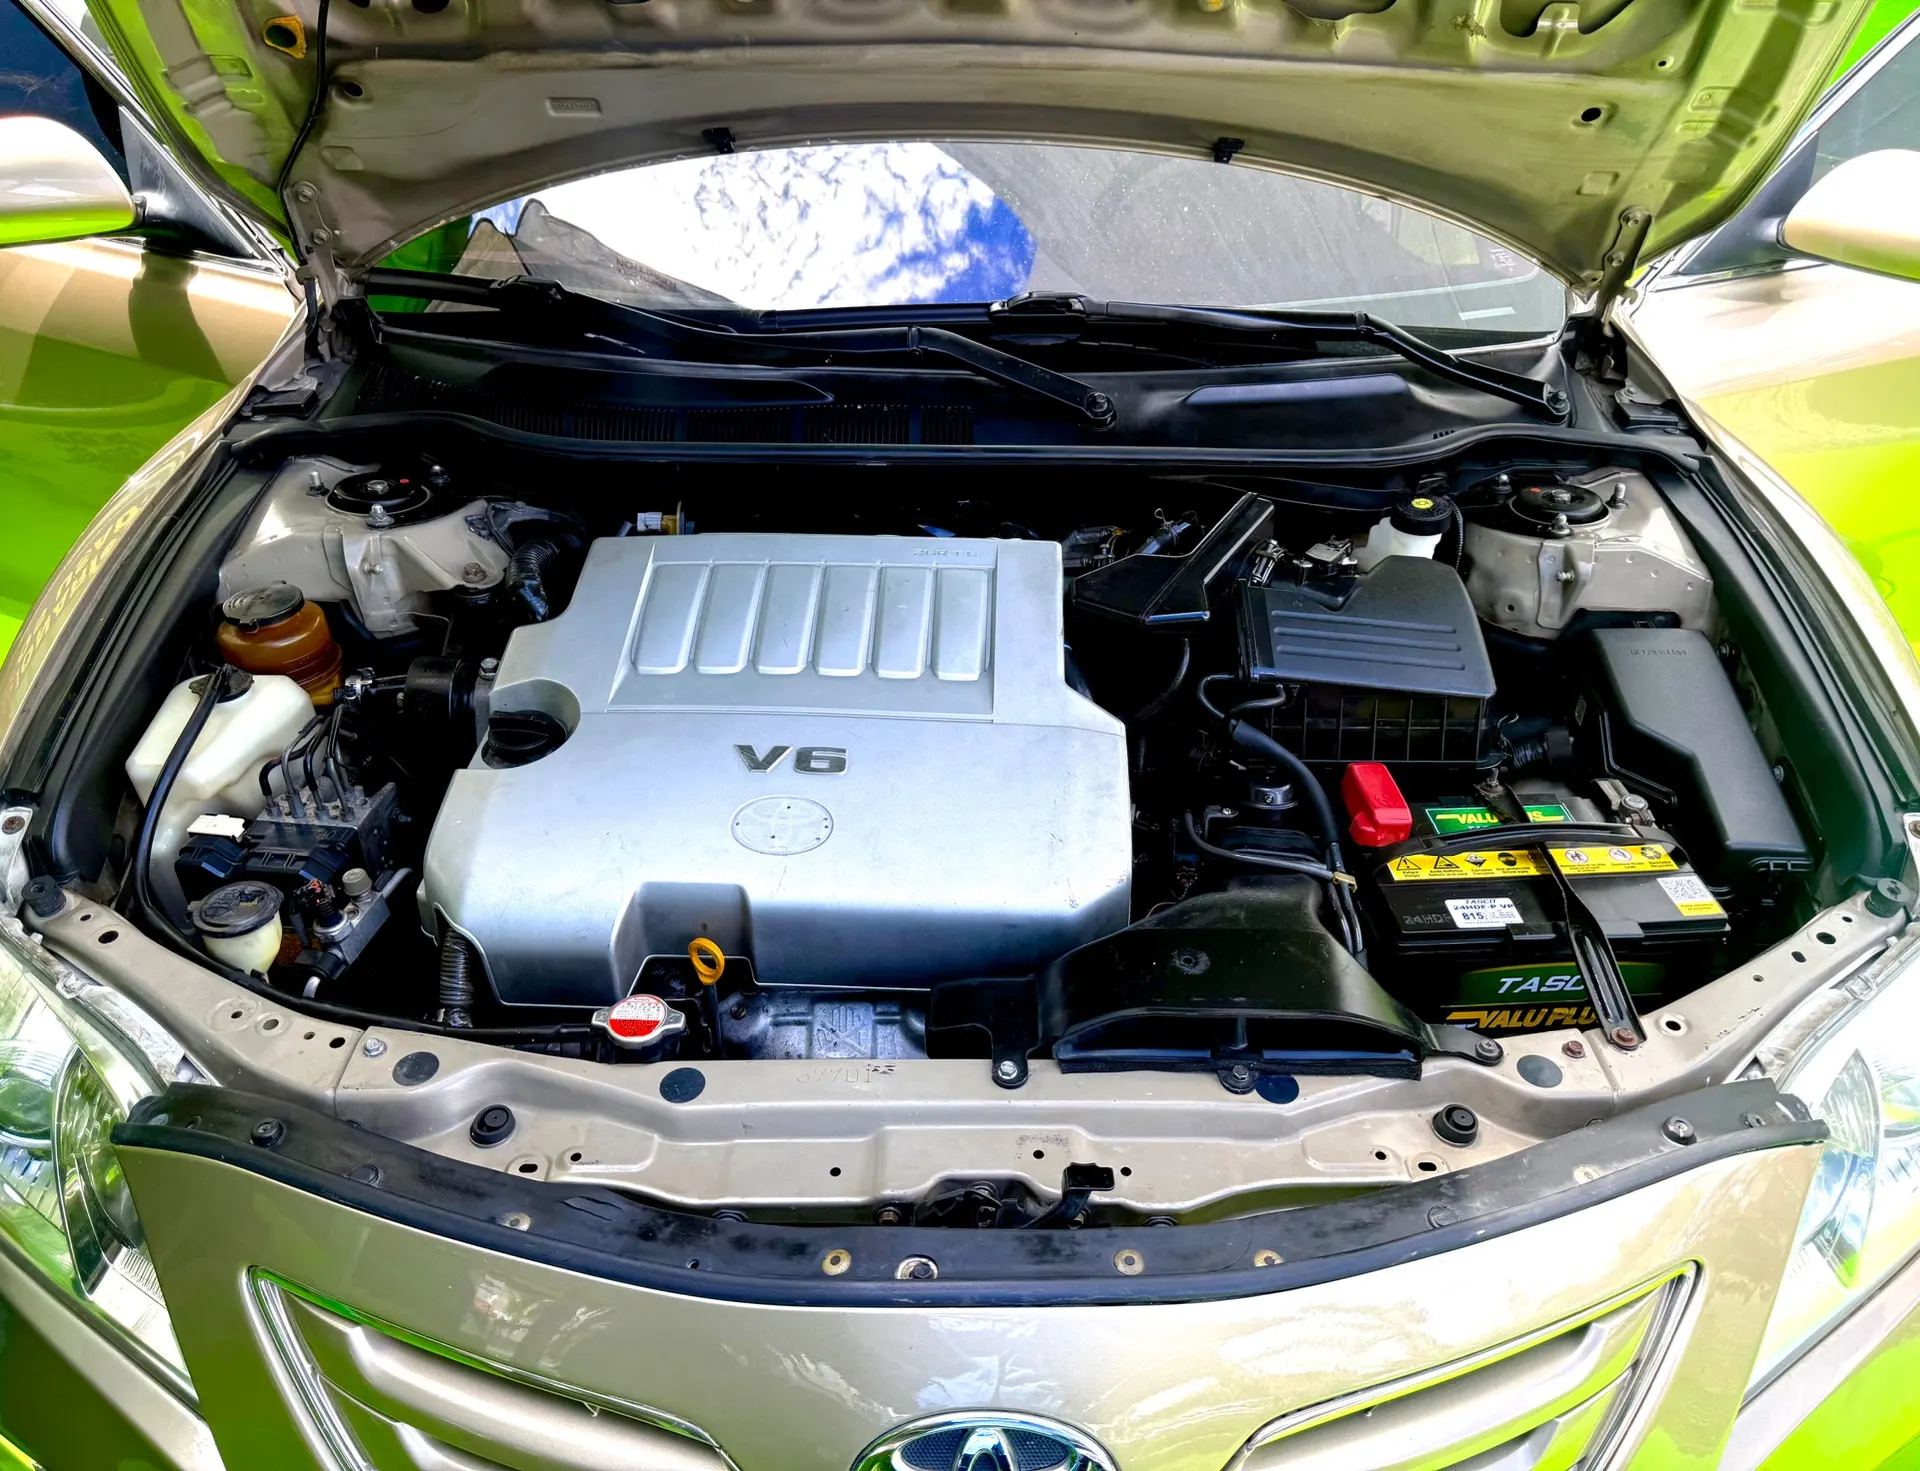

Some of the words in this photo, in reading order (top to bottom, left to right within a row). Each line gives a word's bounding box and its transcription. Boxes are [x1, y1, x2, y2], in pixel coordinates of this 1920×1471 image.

[733, 744, 849, 776] V6
[1462, 911, 1484, 921] 815
[1497, 975, 1585, 994] TASC
[1479, 1009, 1548, 1029] VALU
[1548, 1006, 1596, 1026] PLU
